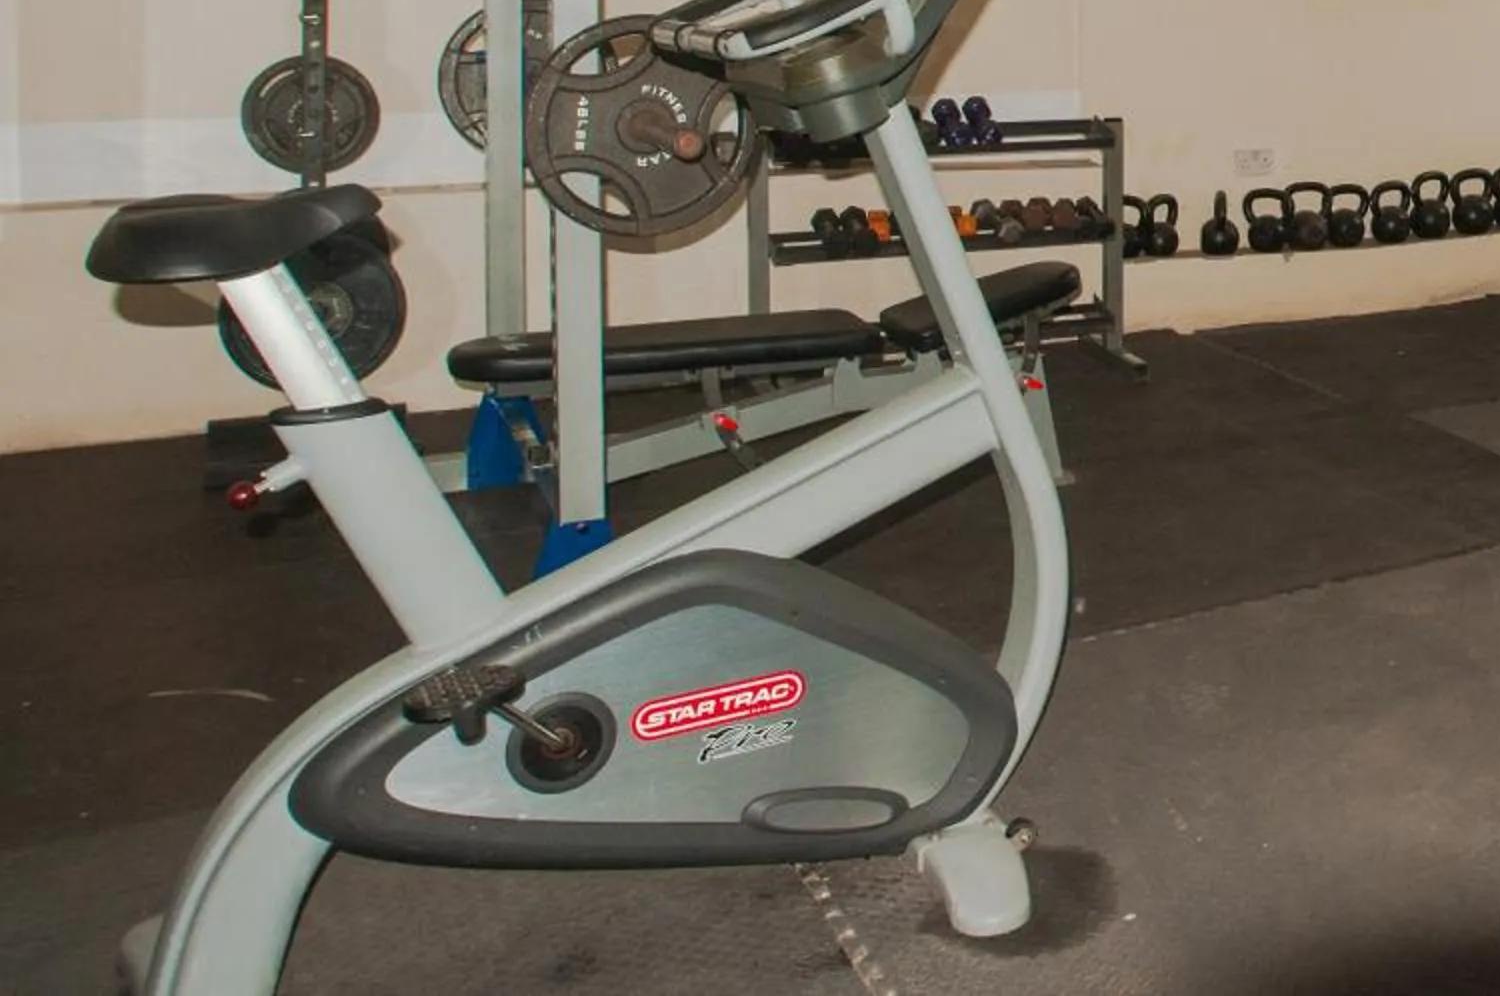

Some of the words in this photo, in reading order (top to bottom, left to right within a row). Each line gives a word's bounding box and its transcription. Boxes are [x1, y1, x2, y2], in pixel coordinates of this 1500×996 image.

[640, 83, 688, 124] FITNES
[647, 702, 717, 726] STAR
[718, 682, 792, 711] TRAC
